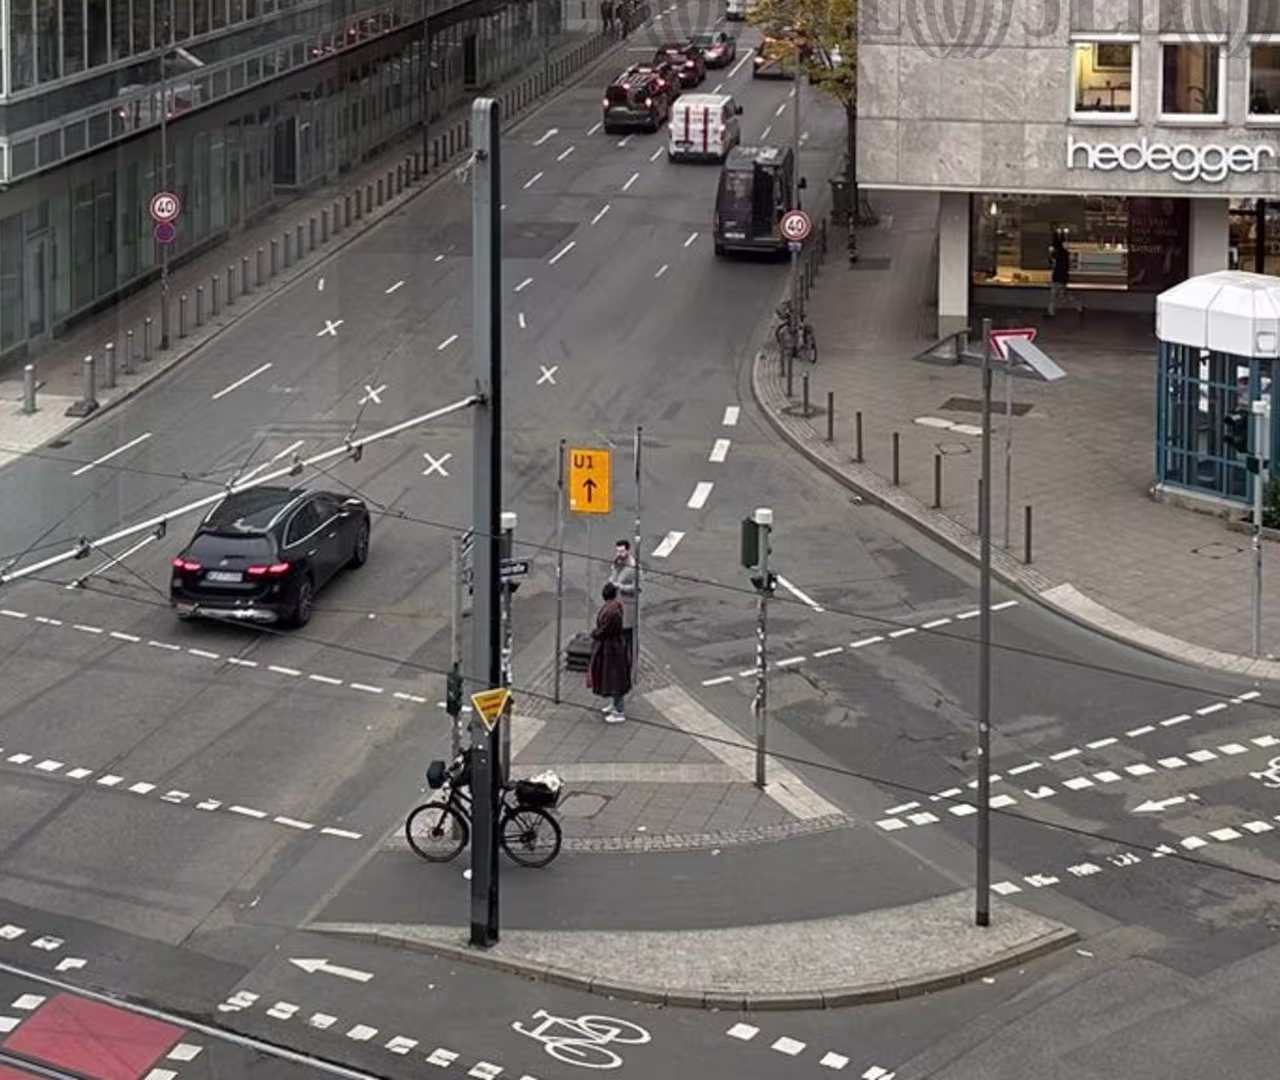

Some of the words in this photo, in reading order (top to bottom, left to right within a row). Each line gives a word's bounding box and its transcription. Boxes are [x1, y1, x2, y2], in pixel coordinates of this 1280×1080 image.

[1066, 135, 1275, 182] hedegger
[158, 200, 173, 213] 40
[788, 219, 804, 232] 40
[573, 453, 593, 469] U1
